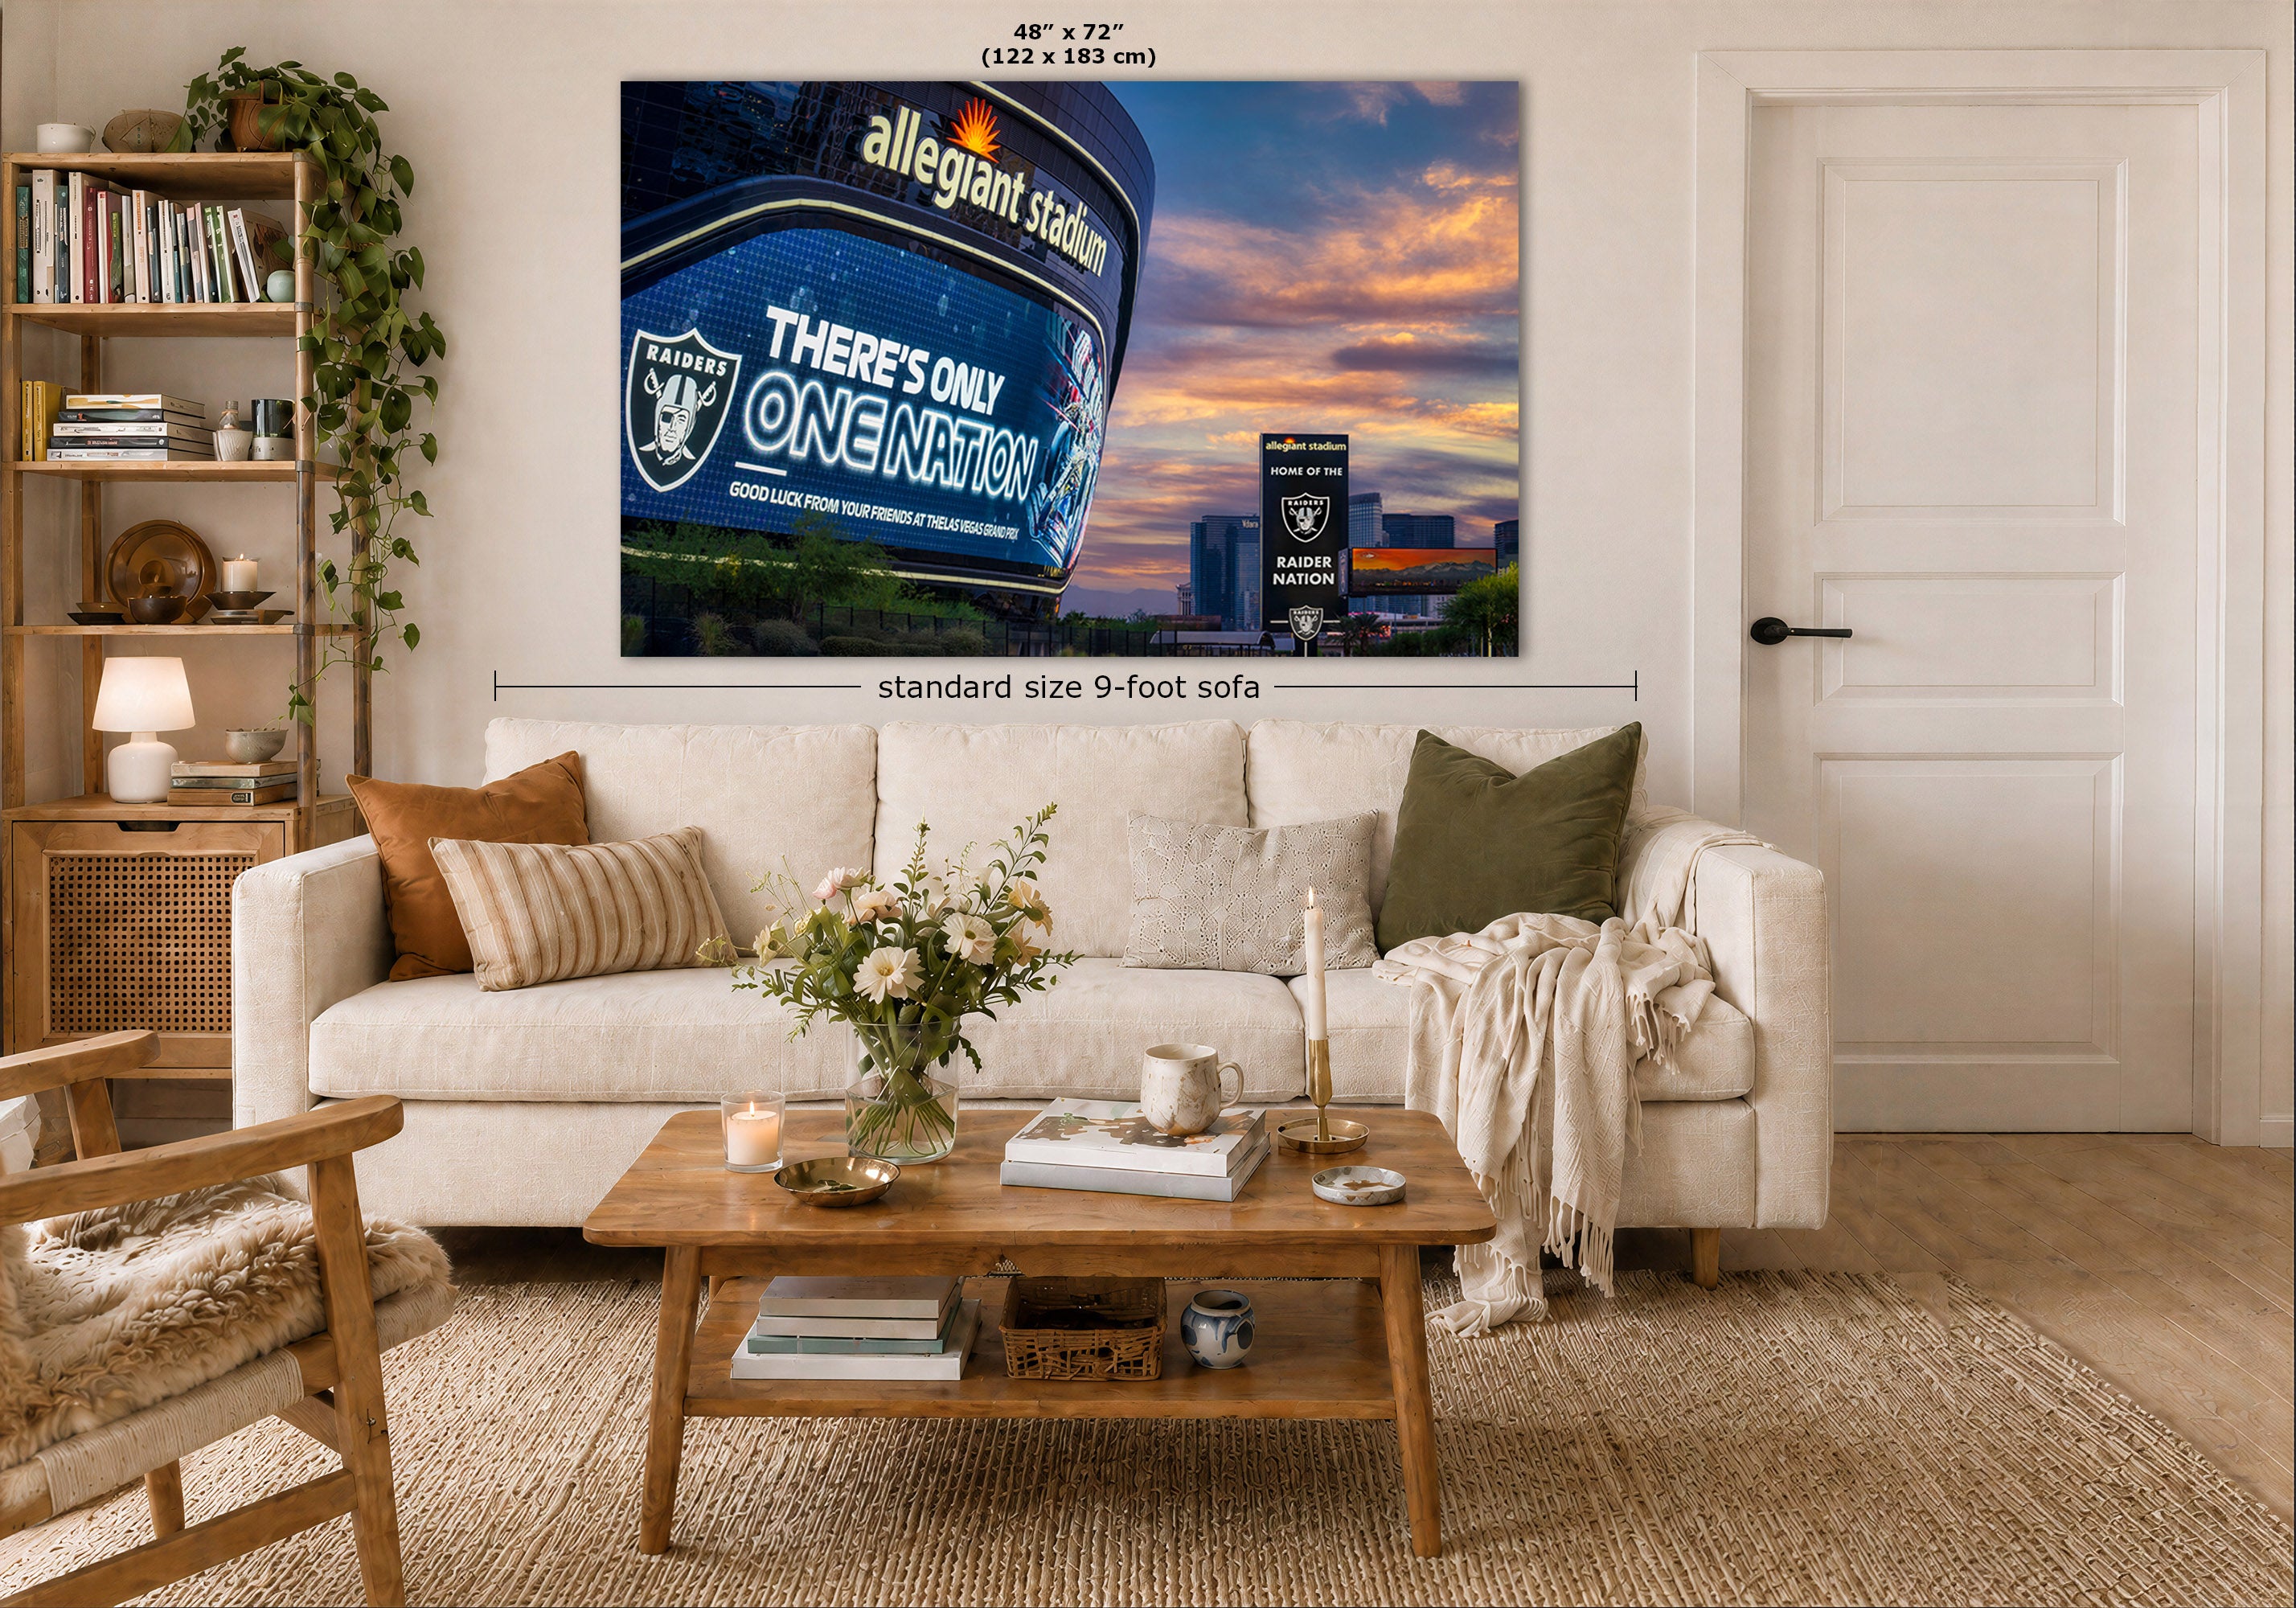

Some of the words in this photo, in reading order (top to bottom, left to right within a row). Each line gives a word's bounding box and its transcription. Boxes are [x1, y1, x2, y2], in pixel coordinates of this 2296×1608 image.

[861, 105, 1026, 224] allegiant
[1027, 187, 1108, 277] stadium
[646, 343, 728, 378] RAIDERS
[766, 306, 930, 395] THERE’S
[930, 356, 1005, 416] ONLY
[744, 371, 888, 471] ONE
[884, 404, 1039, 503] NATION
[1265, 441, 1306, 453] allegiant
[1309, 441, 1347, 451] stadium
[1271, 466, 1303, 476] HOME
[1306, 467, 1321, 476] OF
[1323, 467, 1343, 476] THE
[729, 481, 769, 502] GOOD
[769, 488, 804, 508] LUCK
[804, 494, 839, 514] FROM
[842, 500, 871, 519] YOUR
[871, 505, 913, 525] FRIENDS
[912, 511, 926, 527] AT
[959, 519, 984, 537] VEGAS
[983, 523, 1006, 539] GRAND
[1005, 527, 1019, 540] PRIX
[1273, 572, 1335, 585] NATION
[1277, 556, 1332, 568] RAIDER
